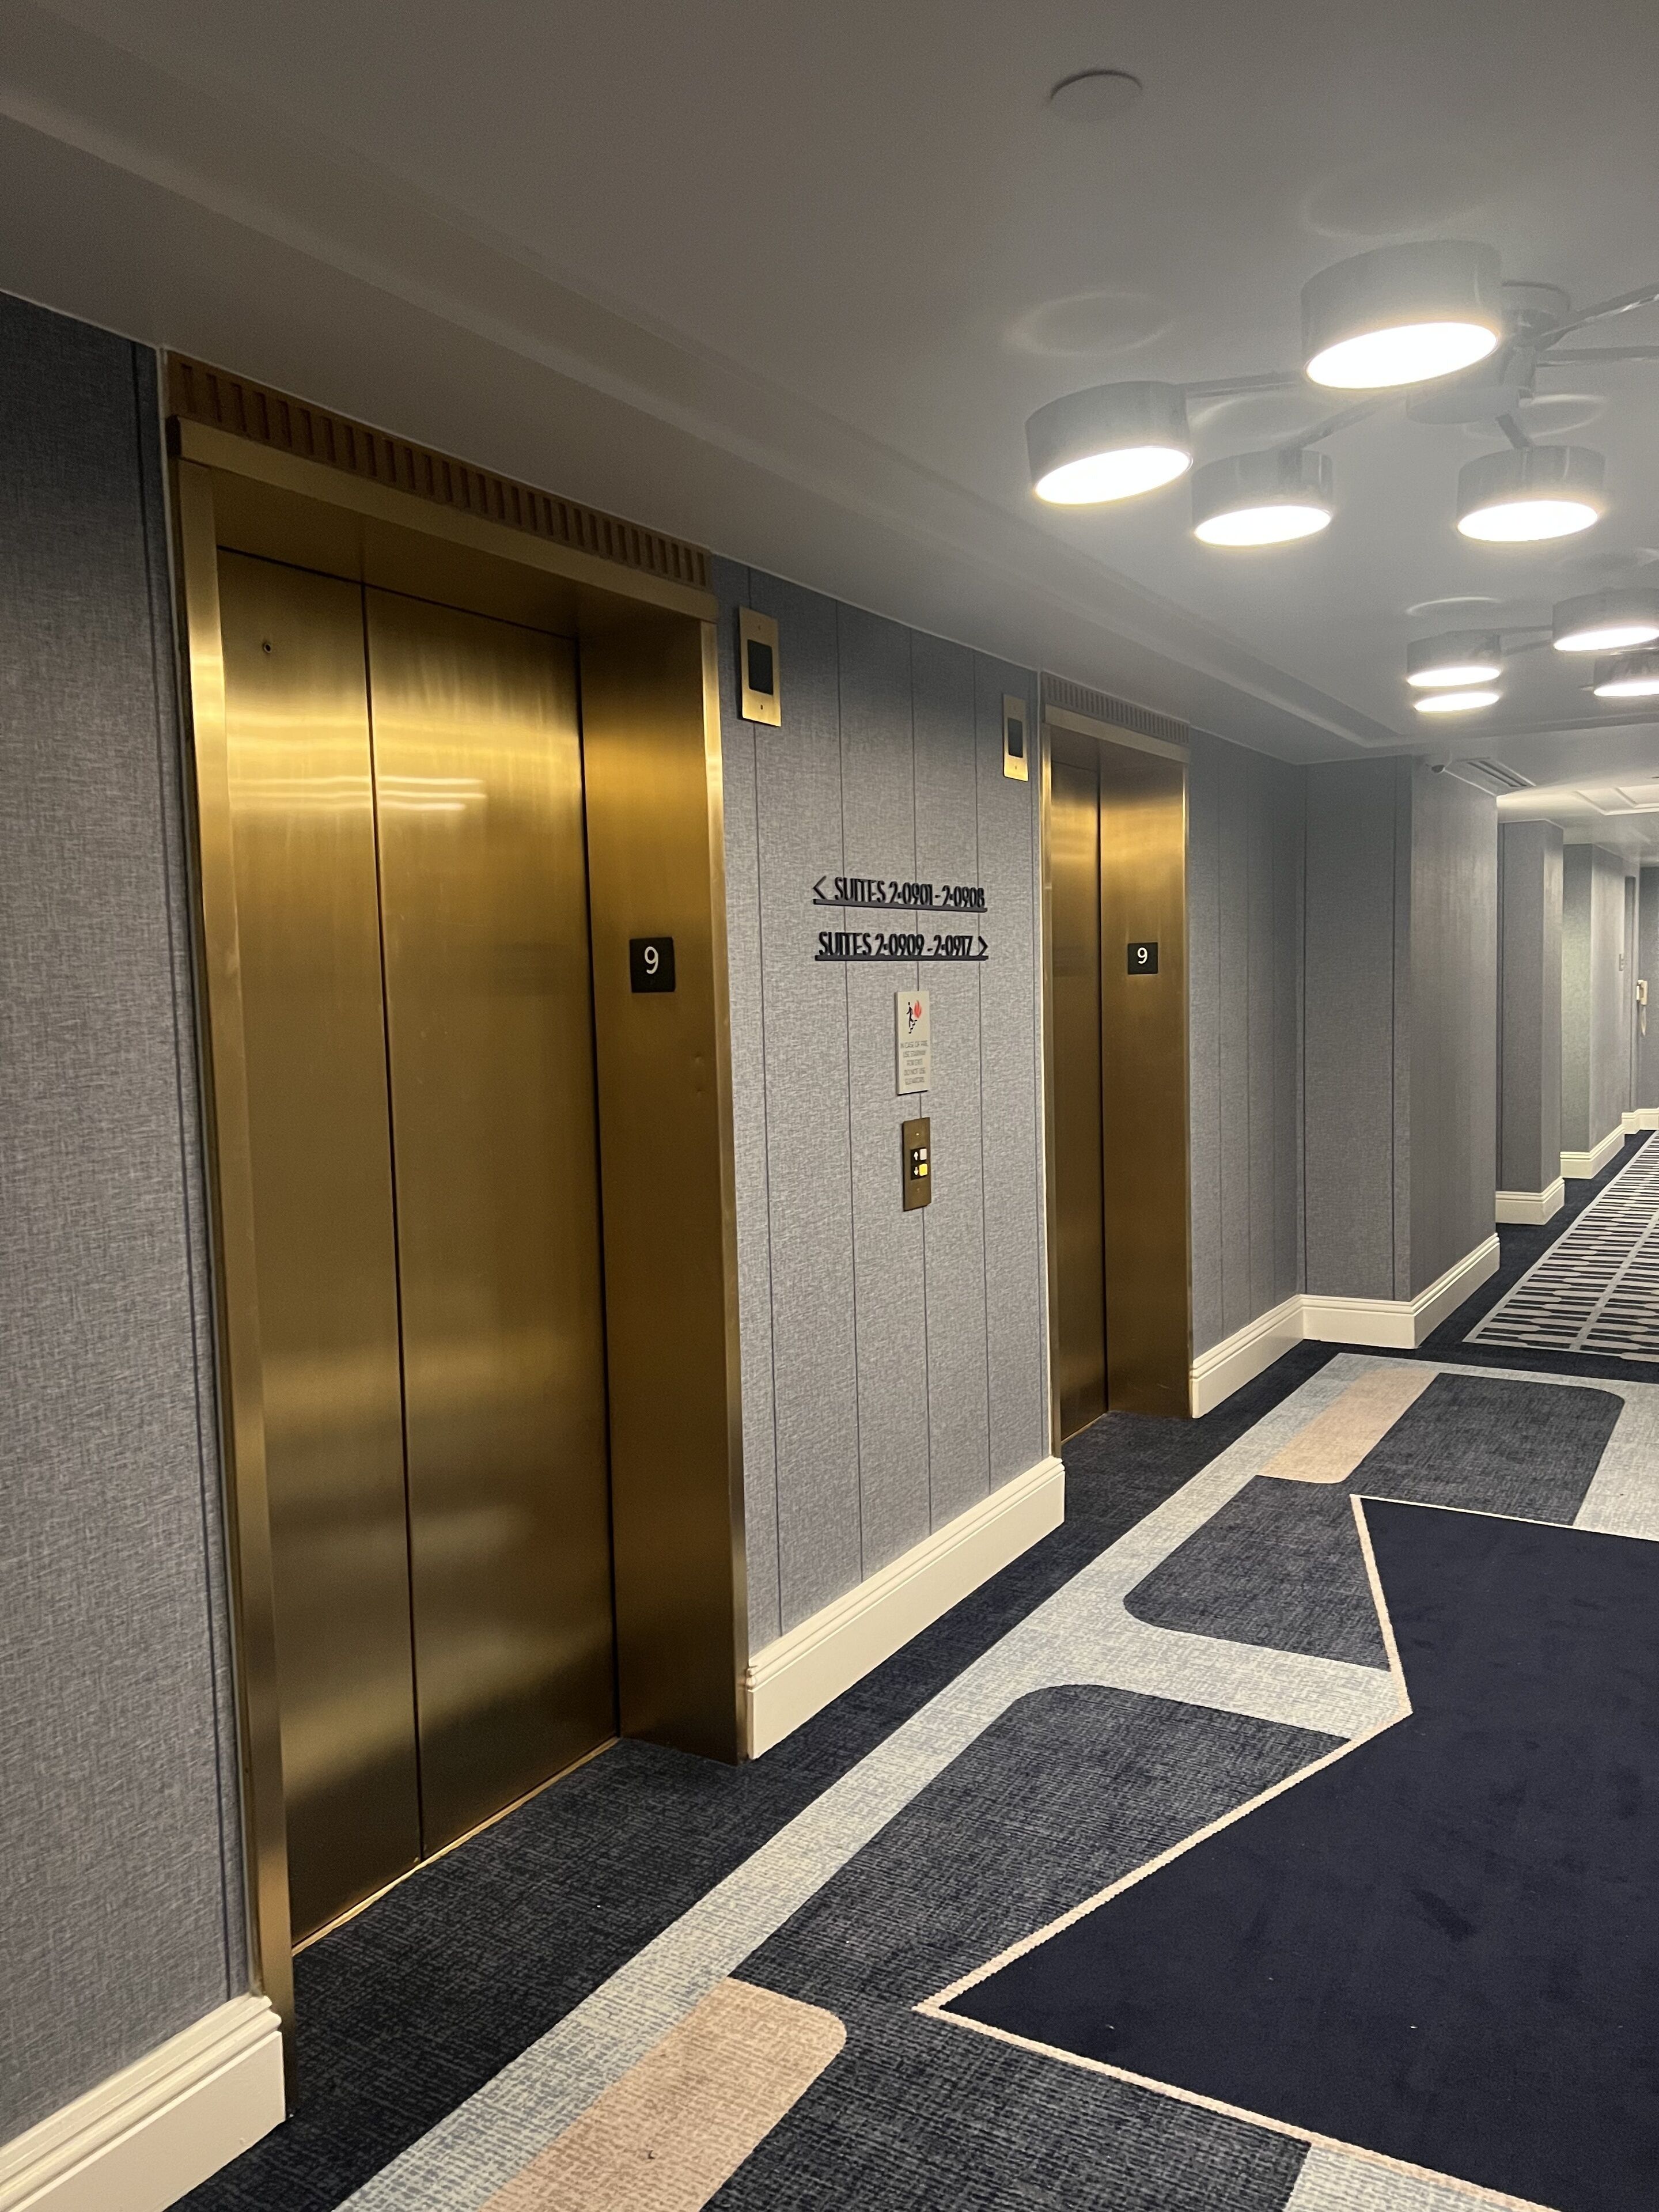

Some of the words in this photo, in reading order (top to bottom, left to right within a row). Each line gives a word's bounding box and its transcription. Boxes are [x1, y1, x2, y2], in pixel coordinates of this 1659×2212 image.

[835, 877, 886, 903] SUITES
[819, 931, 872, 956] SUITES
[1137, 947, 1148, 964] 9
[644, 946, 658, 974] 9
